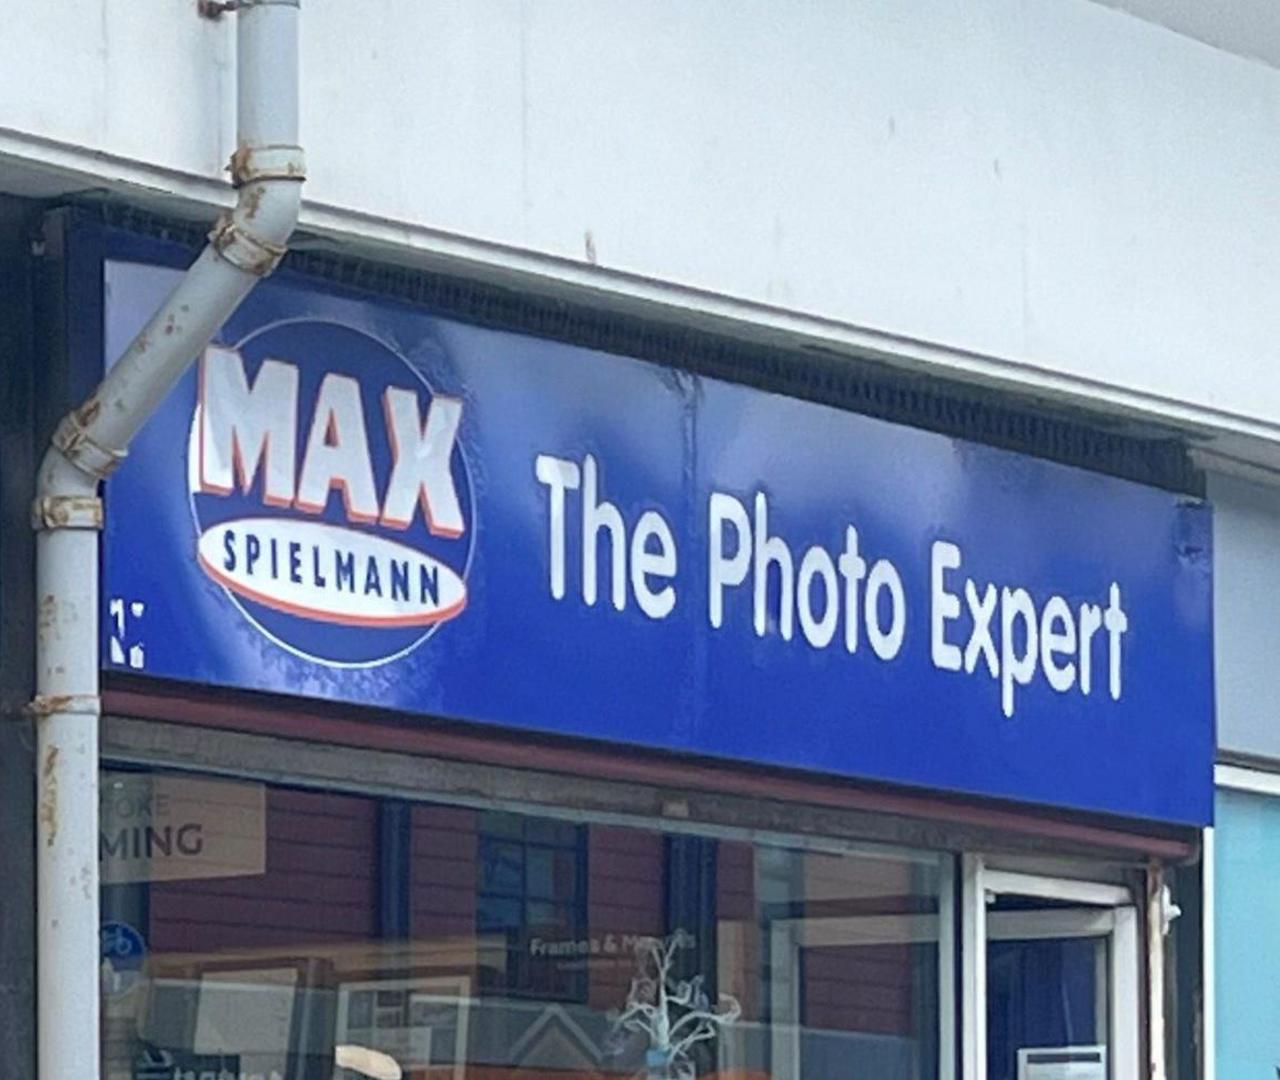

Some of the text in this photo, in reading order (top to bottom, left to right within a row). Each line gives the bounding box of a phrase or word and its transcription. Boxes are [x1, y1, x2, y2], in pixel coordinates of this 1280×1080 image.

[200, 345, 466, 538] MAX
[223, 529, 440, 608] SPIELMANN
[535, 454, 1128, 717] The Photo Expert
